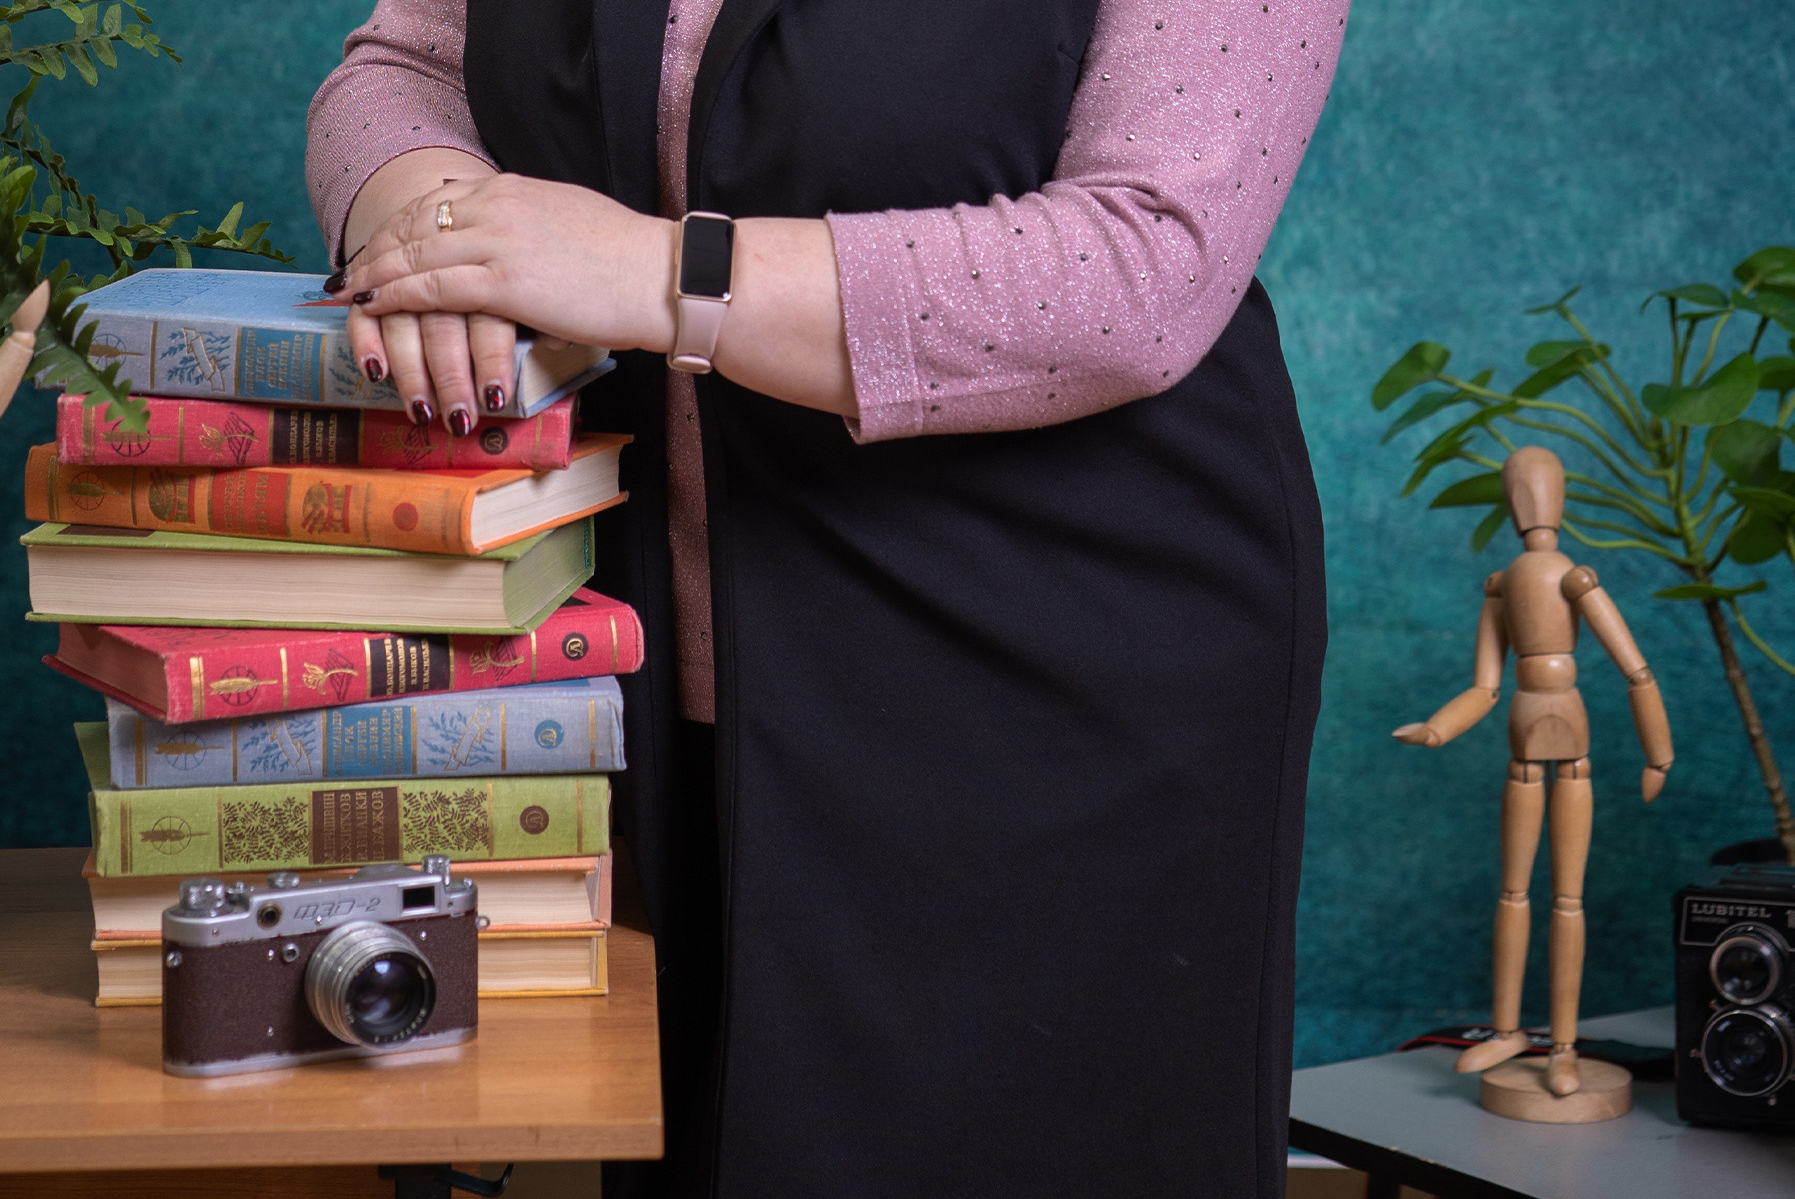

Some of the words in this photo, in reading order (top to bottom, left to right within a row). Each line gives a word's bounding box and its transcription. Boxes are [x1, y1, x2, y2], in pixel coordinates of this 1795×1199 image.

[245, 329, 257, 397] АЛЕКСАНДР
[256, 346, 266, 383] БЛОК
[268, 342, 279, 388] СЕРГЕЙ
[279, 340, 290, 390] ЕСЕНИН
[224, 474, 234, 531] СЕРГЕЙ
[356, 720, 367, 767] СЕРГЕЙ
[369, 716, 379, 767] ЕСЕНИН
[323, 792, 336, 865] М.ПРИШВИН
[355, 790, 368, 862] В.БИАНКИ
[371, 789, 385, 862] П.БАЖОВ
[1691, 903, 1772, 918] LUBITEL
